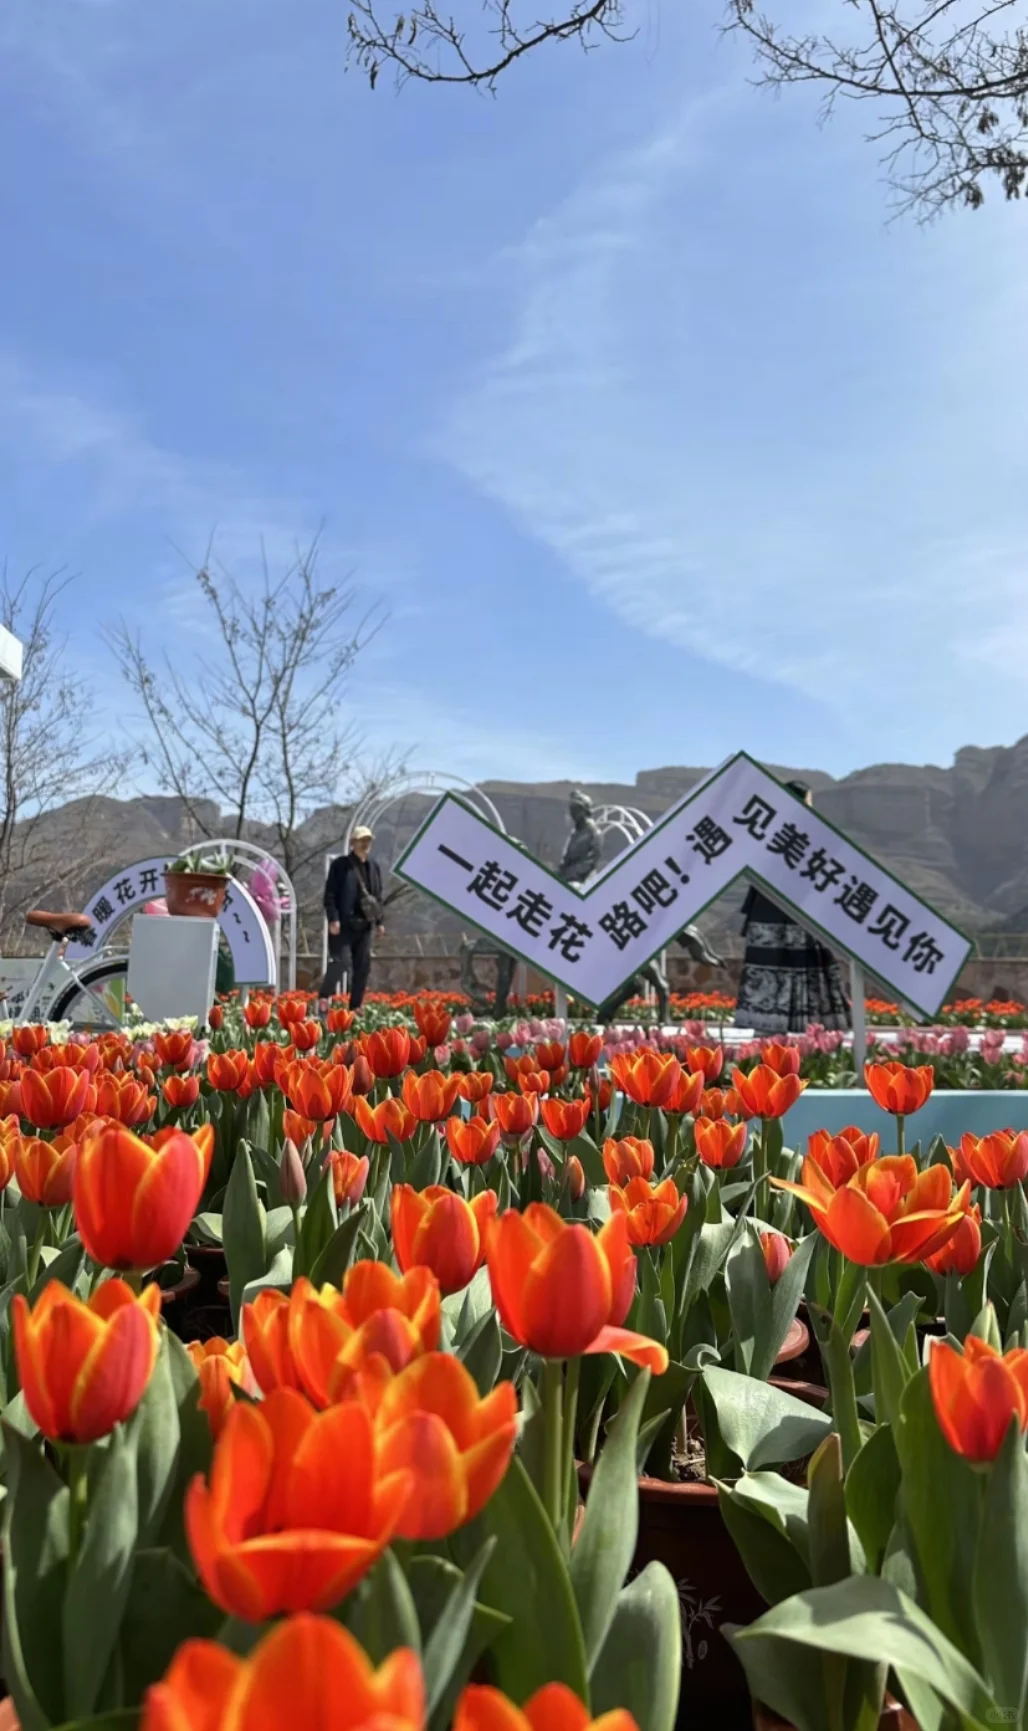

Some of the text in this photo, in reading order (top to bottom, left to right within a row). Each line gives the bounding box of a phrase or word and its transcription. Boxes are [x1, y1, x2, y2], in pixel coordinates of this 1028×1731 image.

[439, 844, 593, 962] 一起走花
[733, 794, 943, 975] 见美好遇见你
